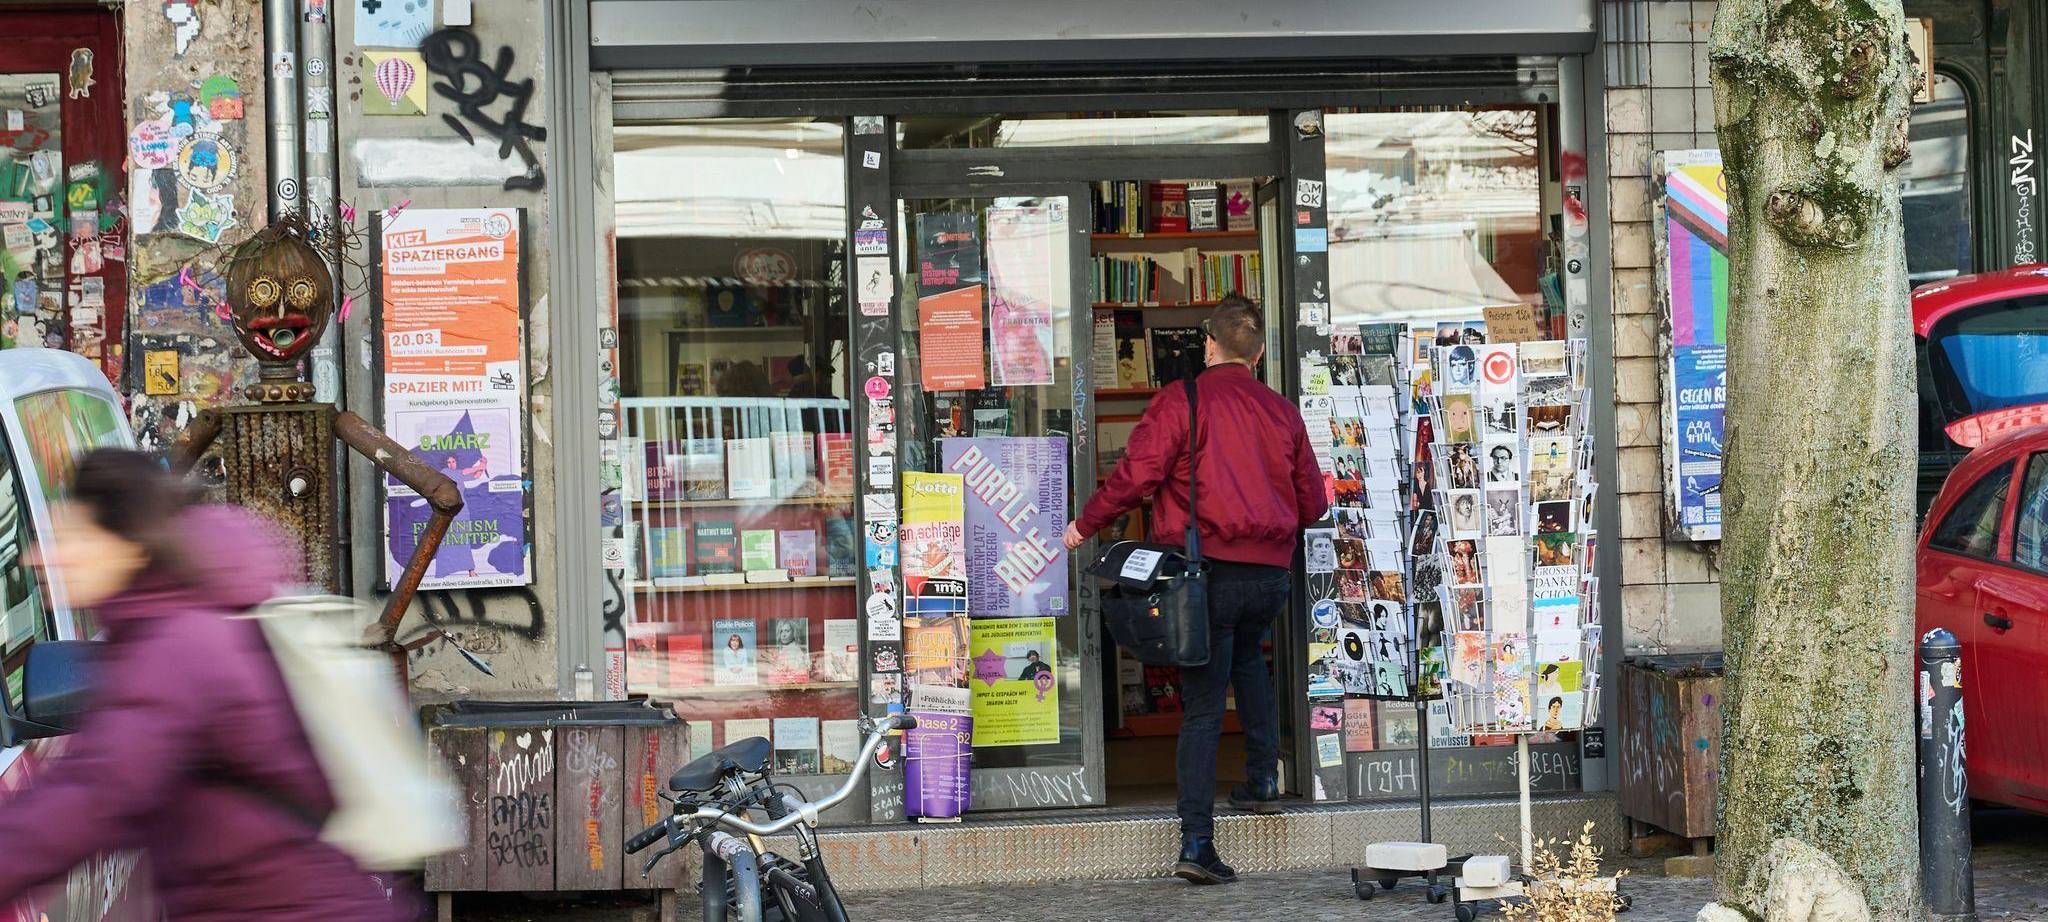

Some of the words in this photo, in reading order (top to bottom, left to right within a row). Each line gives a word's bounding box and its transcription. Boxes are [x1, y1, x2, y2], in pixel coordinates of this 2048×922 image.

[1301, 193, 1319, 205] OK
[390, 231, 425, 249] KIEZ
[391, 246, 500, 263] SPAZIERGANG
[392, 332, 439, 347] 20.03.
[389, 382, 448, 394] SPAZIER
[452, 380, 483, 392] MIT!
[1680, 387, 1712, 404] GEGEN
[409, 400, 449, 408] Kundgebung
[1051, 464, 1062, 476] OF
[647, 479, 672, 489] HUNT
[1039, 443, 1050, 515] INTERNATIONAL
[952, 445, 1040, 535] PURPLE
[1051, 477, 1062, 511] MARCH
[1052, 513, 1063, 538] 2026
[974, 523, 985, 611] MARIANNENPLATZ
[993, 527, 1060, 597] RIDE
[1535, 567, 1577, 576] GROSSES
[1535, 576, 1576, 588] DANKE
[950, 718, 958, 730] 2
